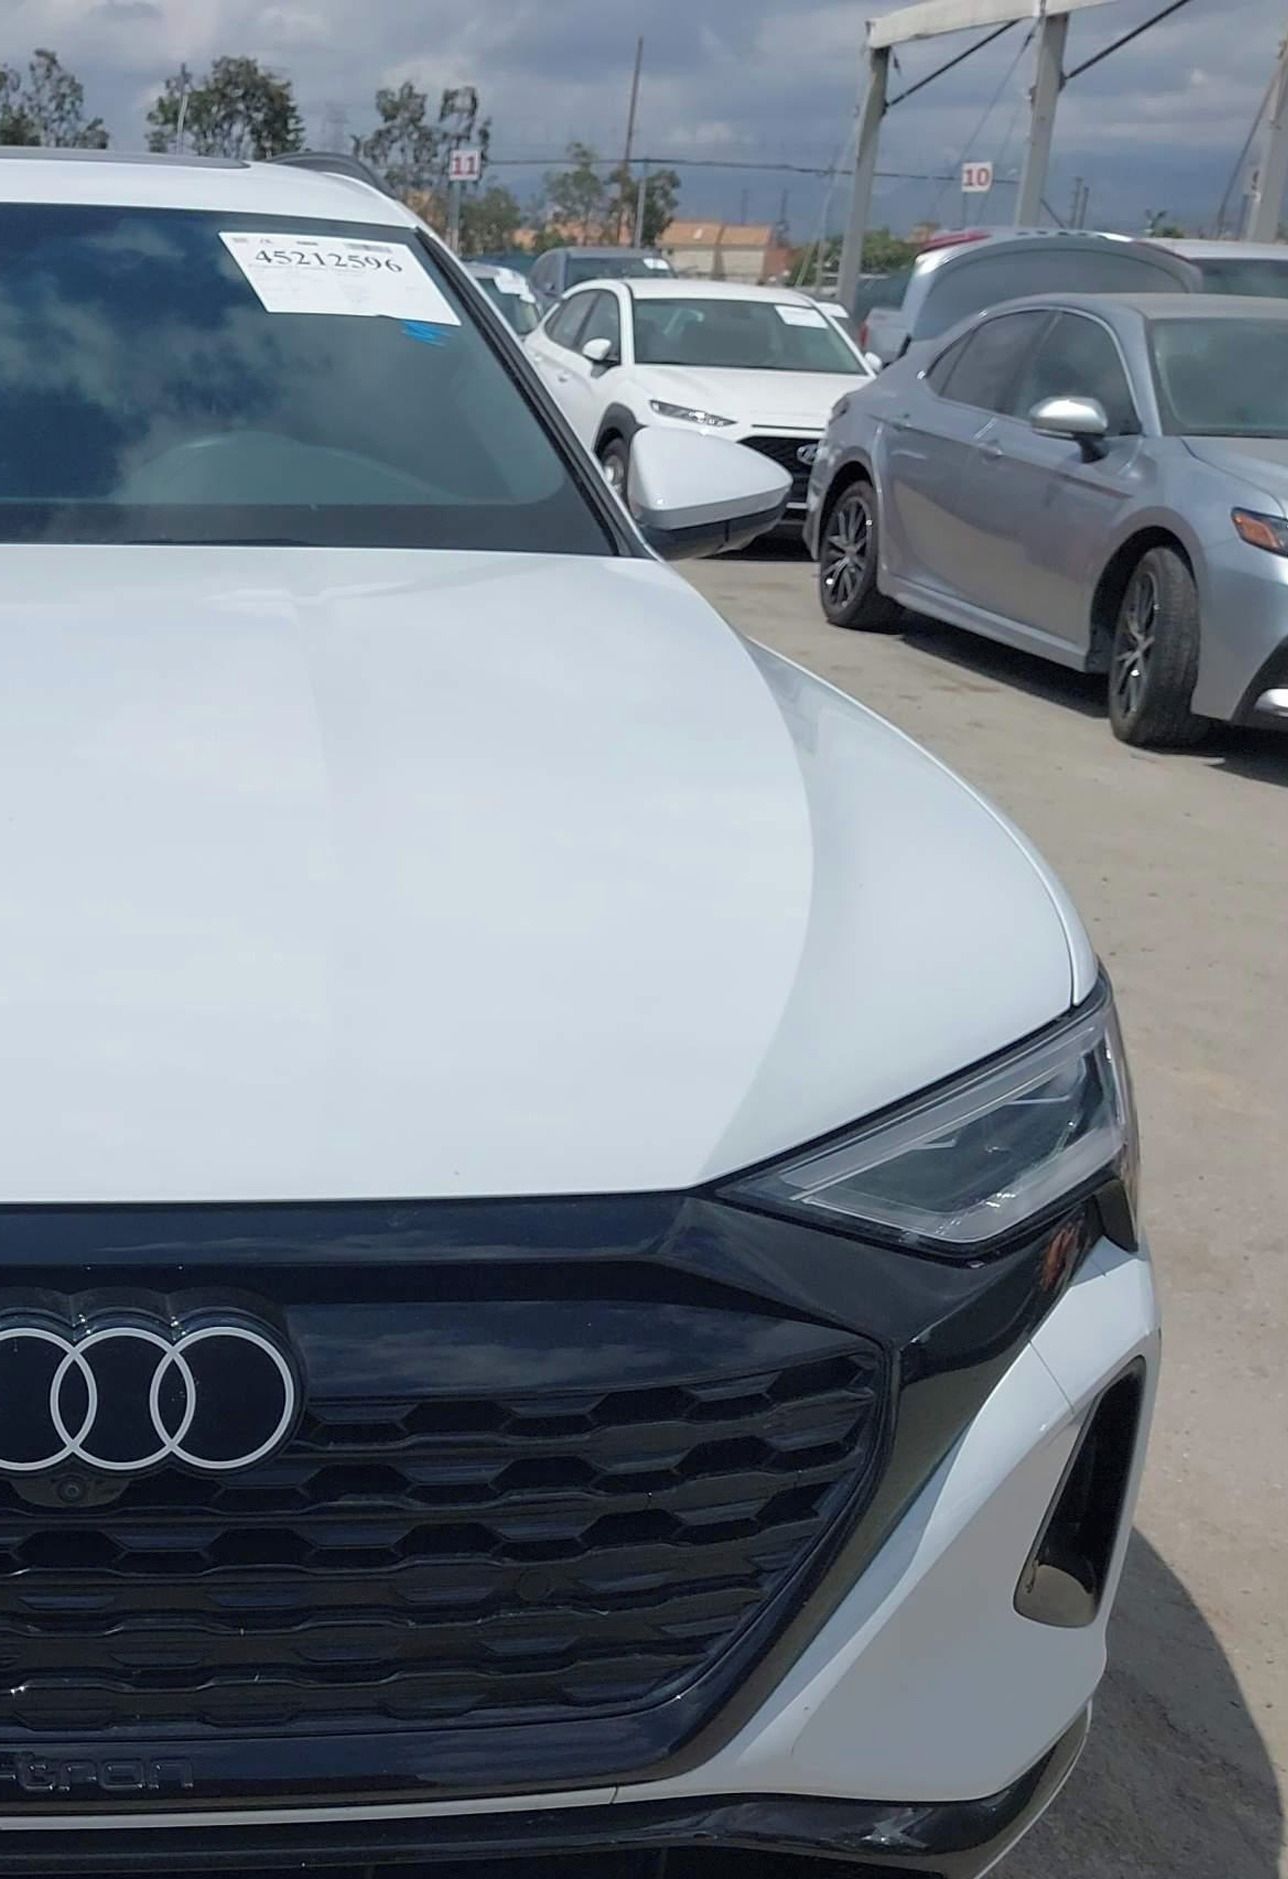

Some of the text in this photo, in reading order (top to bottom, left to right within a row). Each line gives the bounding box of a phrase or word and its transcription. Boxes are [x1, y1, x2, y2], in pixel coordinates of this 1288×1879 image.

[454, 156, 475, 175] 11
[964, 167, 990, 187] 10
[255, 249, 403, 273] 45212596
